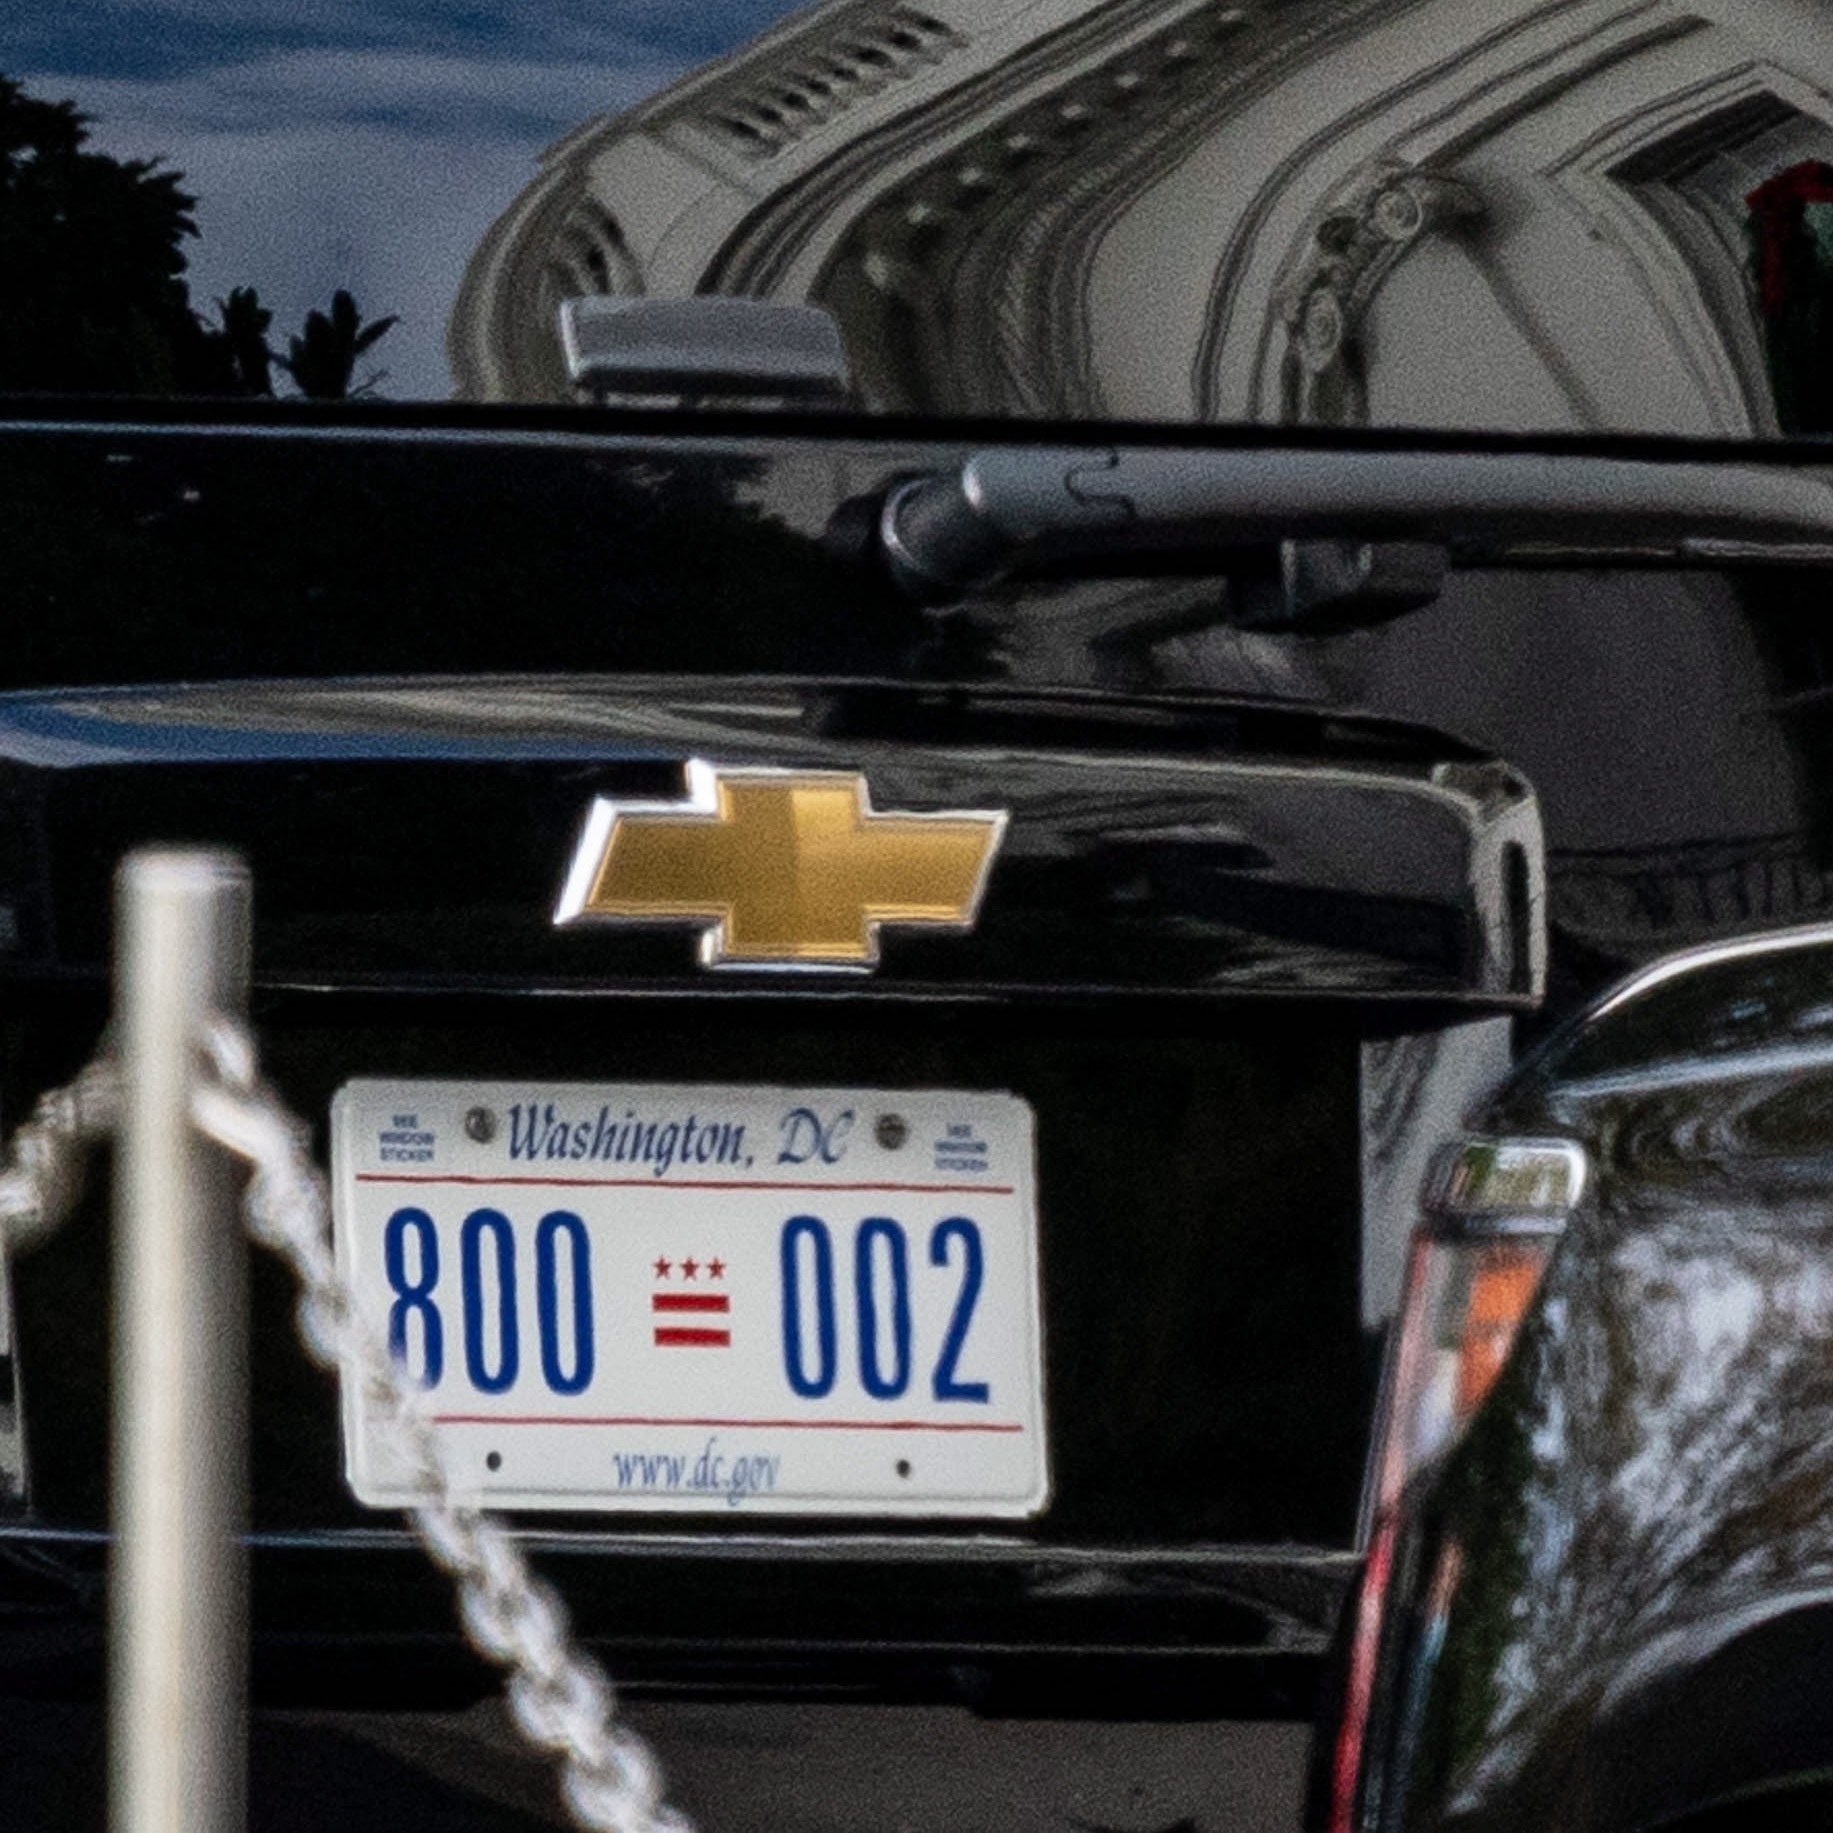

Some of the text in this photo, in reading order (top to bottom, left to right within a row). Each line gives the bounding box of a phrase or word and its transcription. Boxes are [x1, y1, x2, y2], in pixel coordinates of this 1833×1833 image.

[508, 1103, 754, 1177] Washington,
[777, 1107, 856, 1164] DC
[384, 1206, 990, 1404] 800 002
[612, 1436, 781, 1507] www.dc.gov
